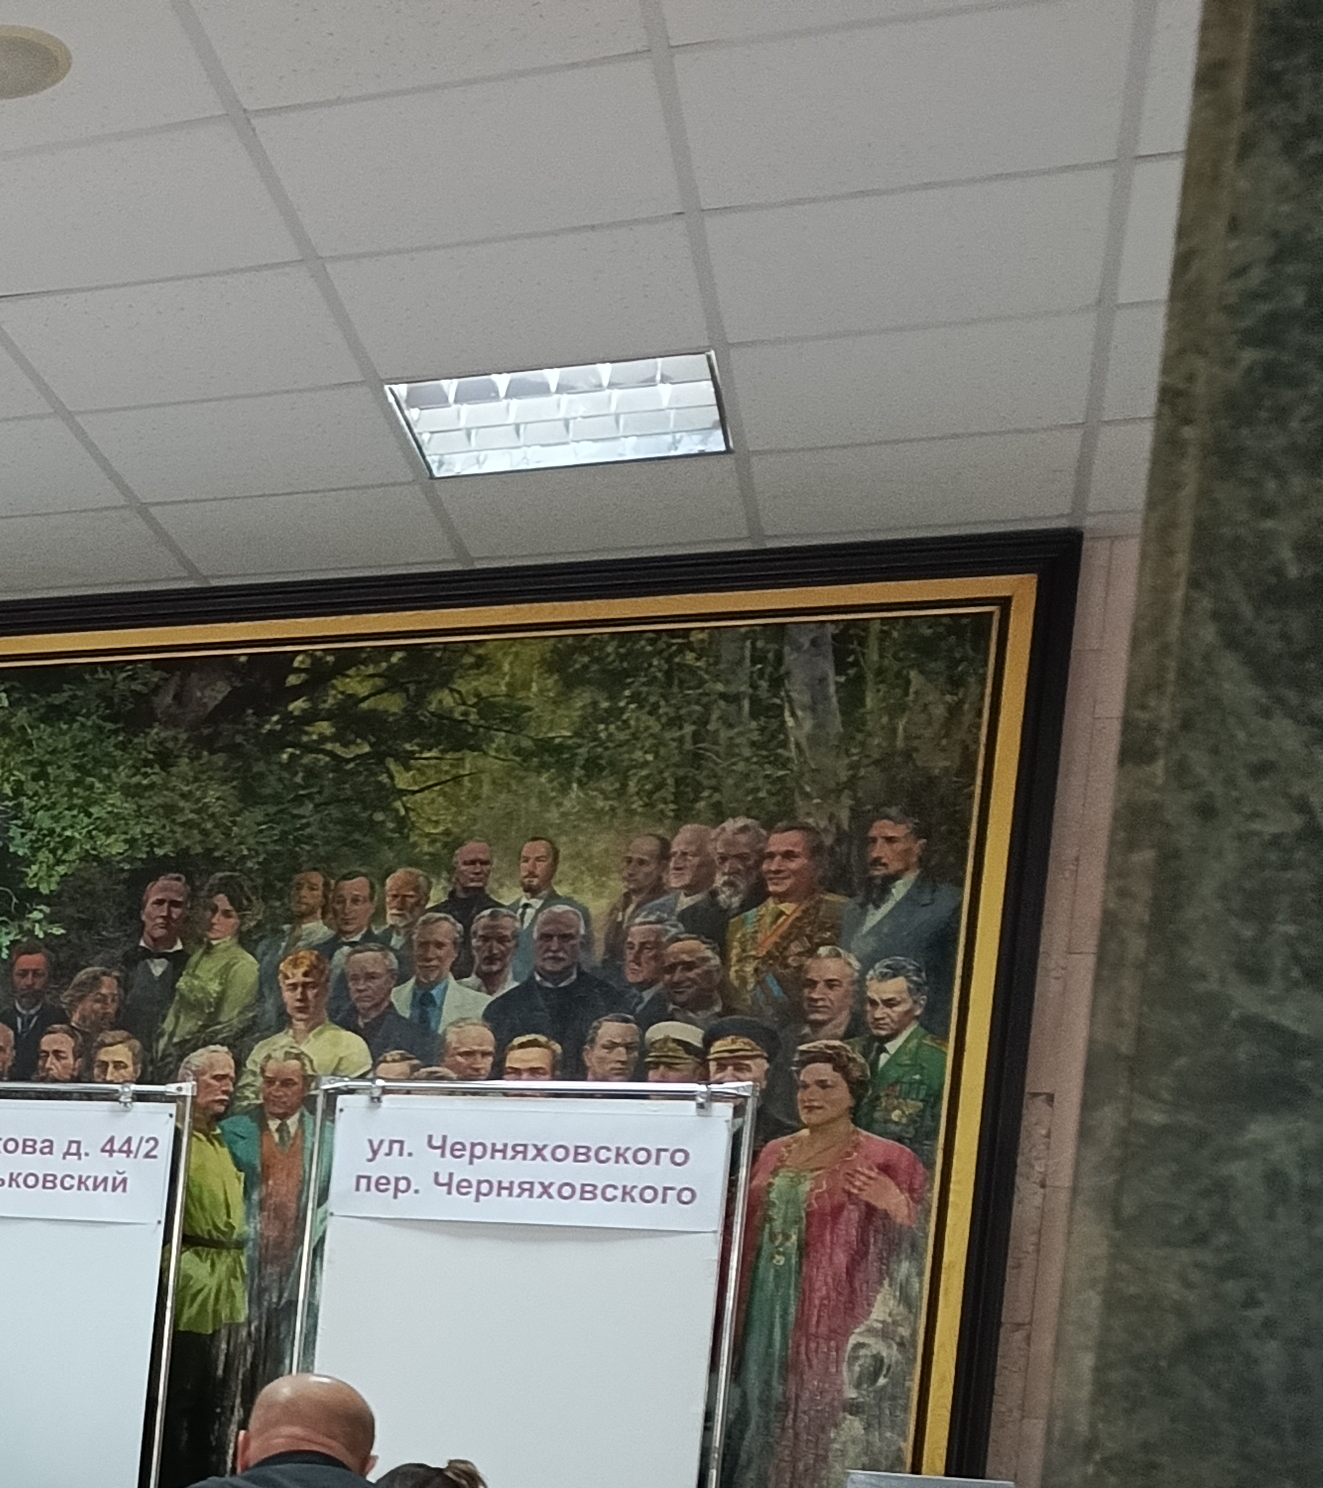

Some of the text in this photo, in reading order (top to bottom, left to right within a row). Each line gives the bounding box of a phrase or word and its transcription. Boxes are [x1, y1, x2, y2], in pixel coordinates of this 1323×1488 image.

[62, 1139, 91, 1161] д.
[100, 1135, 159, 1160] 44/2
[366, 1134, 691, 1168] ул. Черняховского
[354, 1171, 698, 1206] пер. Черняховского
